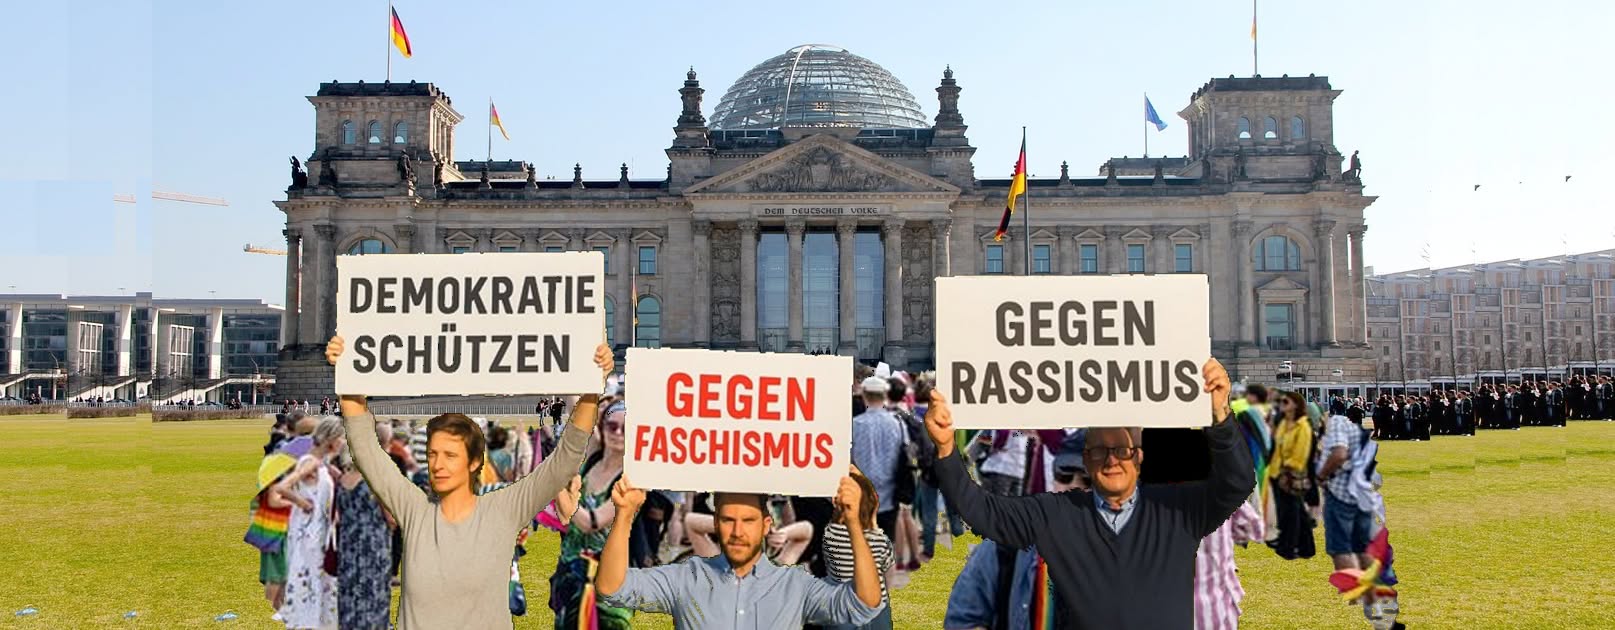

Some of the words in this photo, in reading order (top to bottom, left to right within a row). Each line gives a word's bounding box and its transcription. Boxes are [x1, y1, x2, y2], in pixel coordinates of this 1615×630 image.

[764, 207, 785, 215] DEM
[791, 207, 844, 215] DEUTSCHEN
[349, 275, 596, 315] DEMOKRATIE
[995, 300, 1156, 348] GEGEN
[352, 322, 570, 374] SCHÜTZEN
[665, 371, 816, 422] GEGEN
[951, 359, 1200, 405] RASSISMUS
[633, 424, 834, 470] FASCHISMUS
